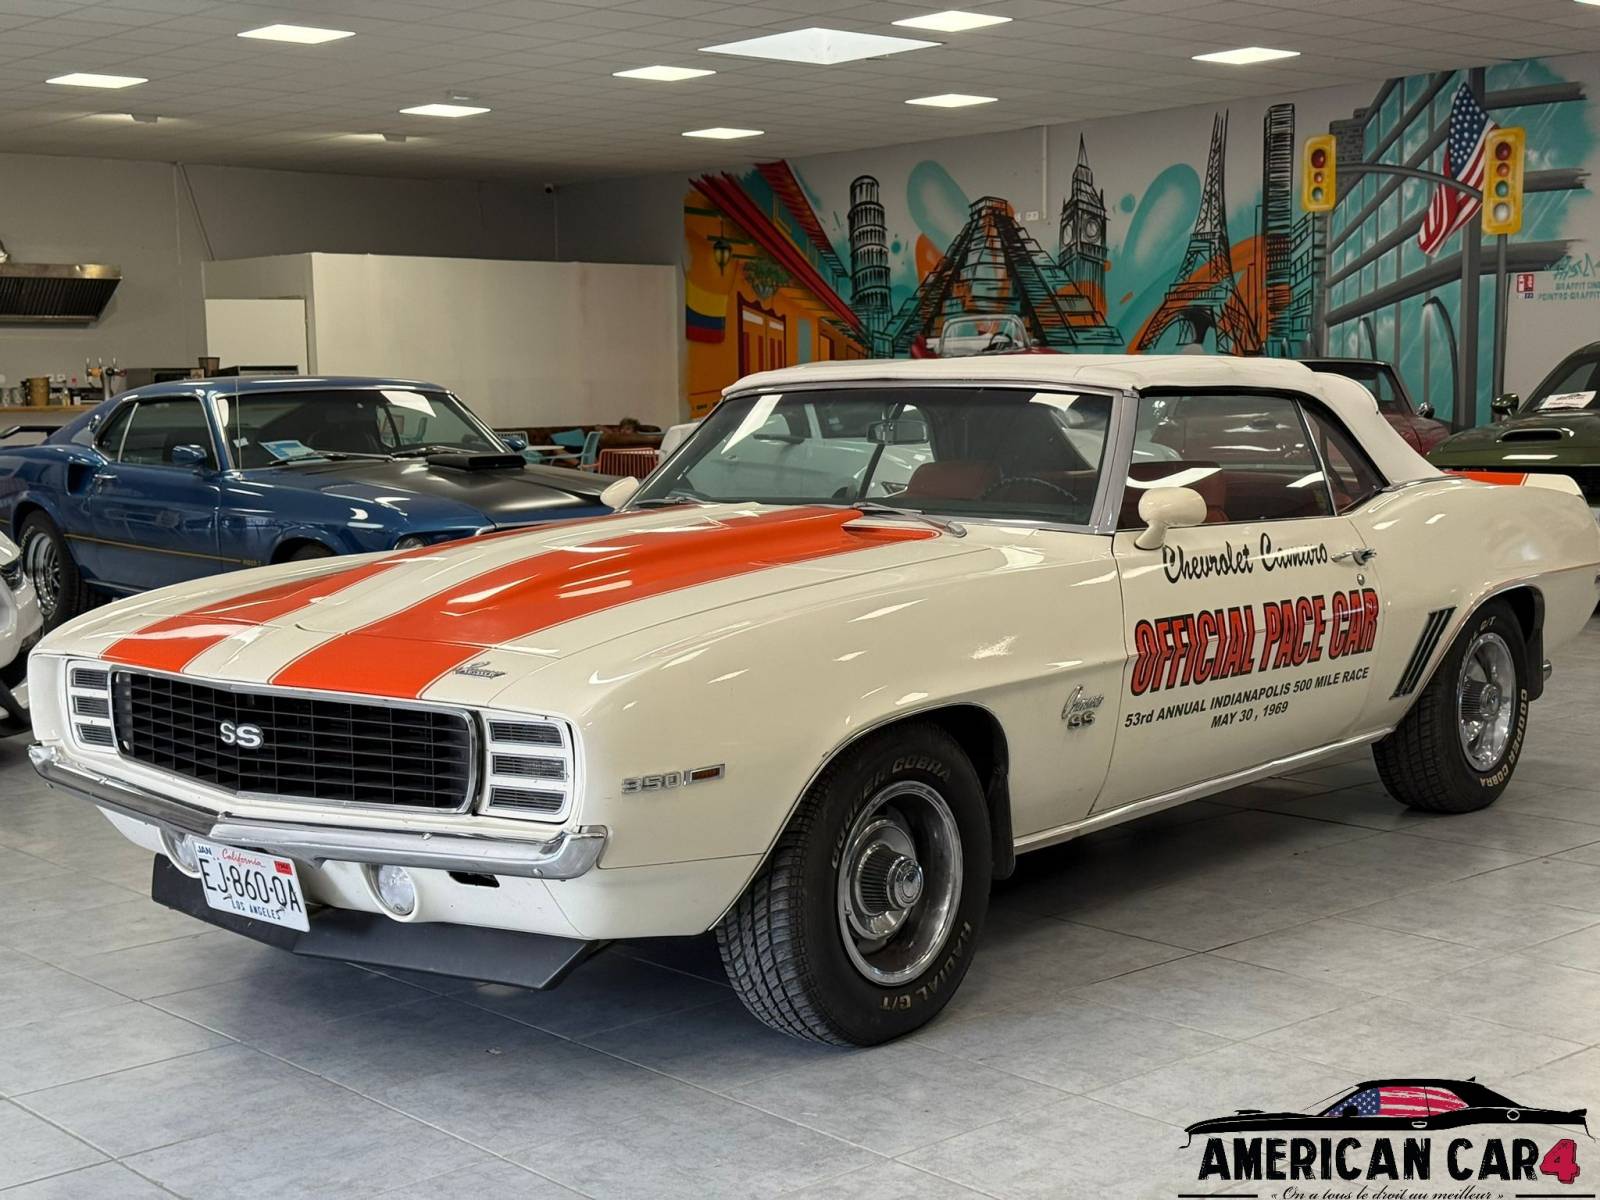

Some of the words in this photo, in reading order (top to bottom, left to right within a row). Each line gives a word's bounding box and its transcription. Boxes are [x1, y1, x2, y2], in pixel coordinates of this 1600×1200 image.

[1163, 541, 1253, 584] Chevrolet
[1260, 533, 1328, 572] Camaro
[1131, 605, 1254, 696] OFFICIAL
[1258, 595, 1326, 673] PACE
[1328, 588, 1379, 660] CAR
[1124, 711, 1154, 728] 53rd
[1156, 699, 1206, 722] ANNUAL
[1210, 683, 1290, 710] INDIANAPOLIS
[1293, 678, 1312, 694] 500
[1314, 672, 1340, 689] MILE
[1342, 667, 1370, 685] RACE
[1067, 711, 1096, 730] SS
[1210, 714, 1238, 729] MAY
[1263, 701, 1289, 718] 1969
[220, 721, 264, 749] SS
[892, 757, 951, 780] COBRA
[1479, 767, 1509, 787] COBRA
[621, 771, 682, 794] 350
[197, 845, 212, 856] JAN
[222, 848, 266, 869] California
[231, 900, 245, 911] LOS
[249, 904, 282, 920] ANGELES
